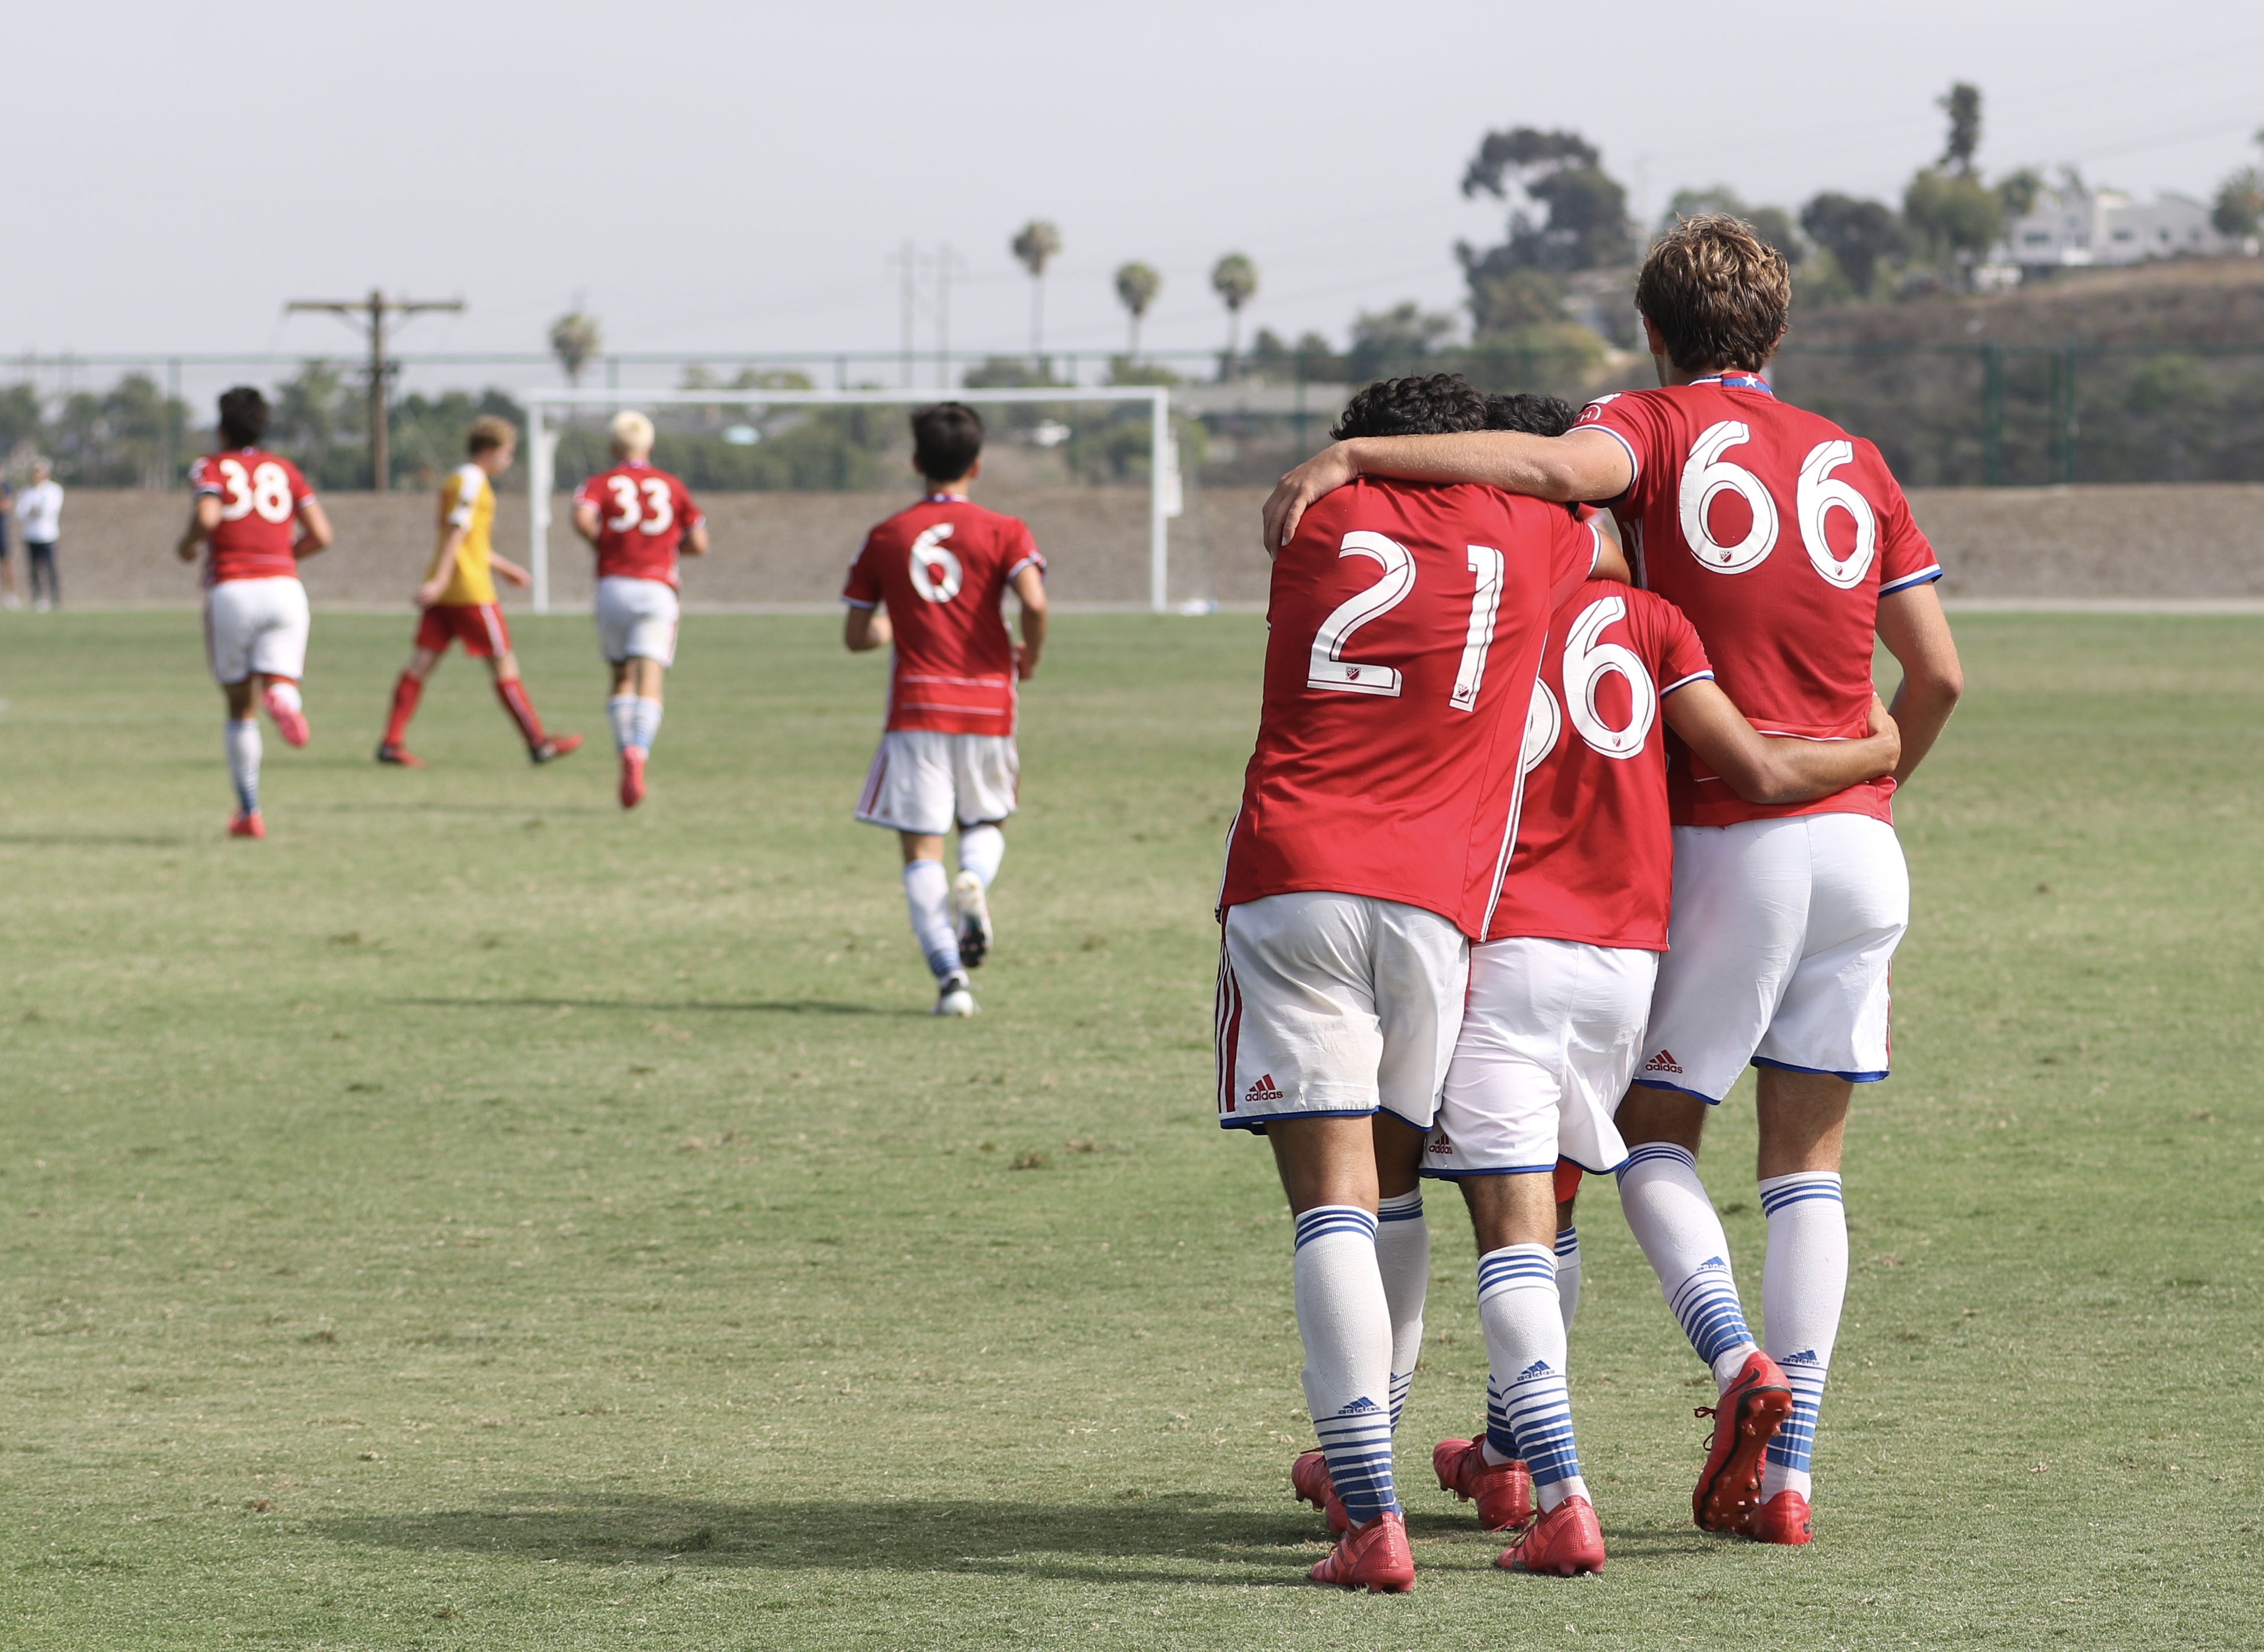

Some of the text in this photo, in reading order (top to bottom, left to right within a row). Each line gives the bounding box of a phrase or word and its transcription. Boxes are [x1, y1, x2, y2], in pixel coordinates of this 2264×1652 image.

[220, 459, 293, 523] 38
[607, 474, 673, 535] 33
[1679, 420, 1876, 589] 66
[909, 522, 963, 603] 6
[1306, 530, 1505, 712] 21
[1245, 1091, 1283, 1102] adidas
[1646, 1063, 1683, 1074] adidas
[1517, 1370, 1555, 1381] adidas
